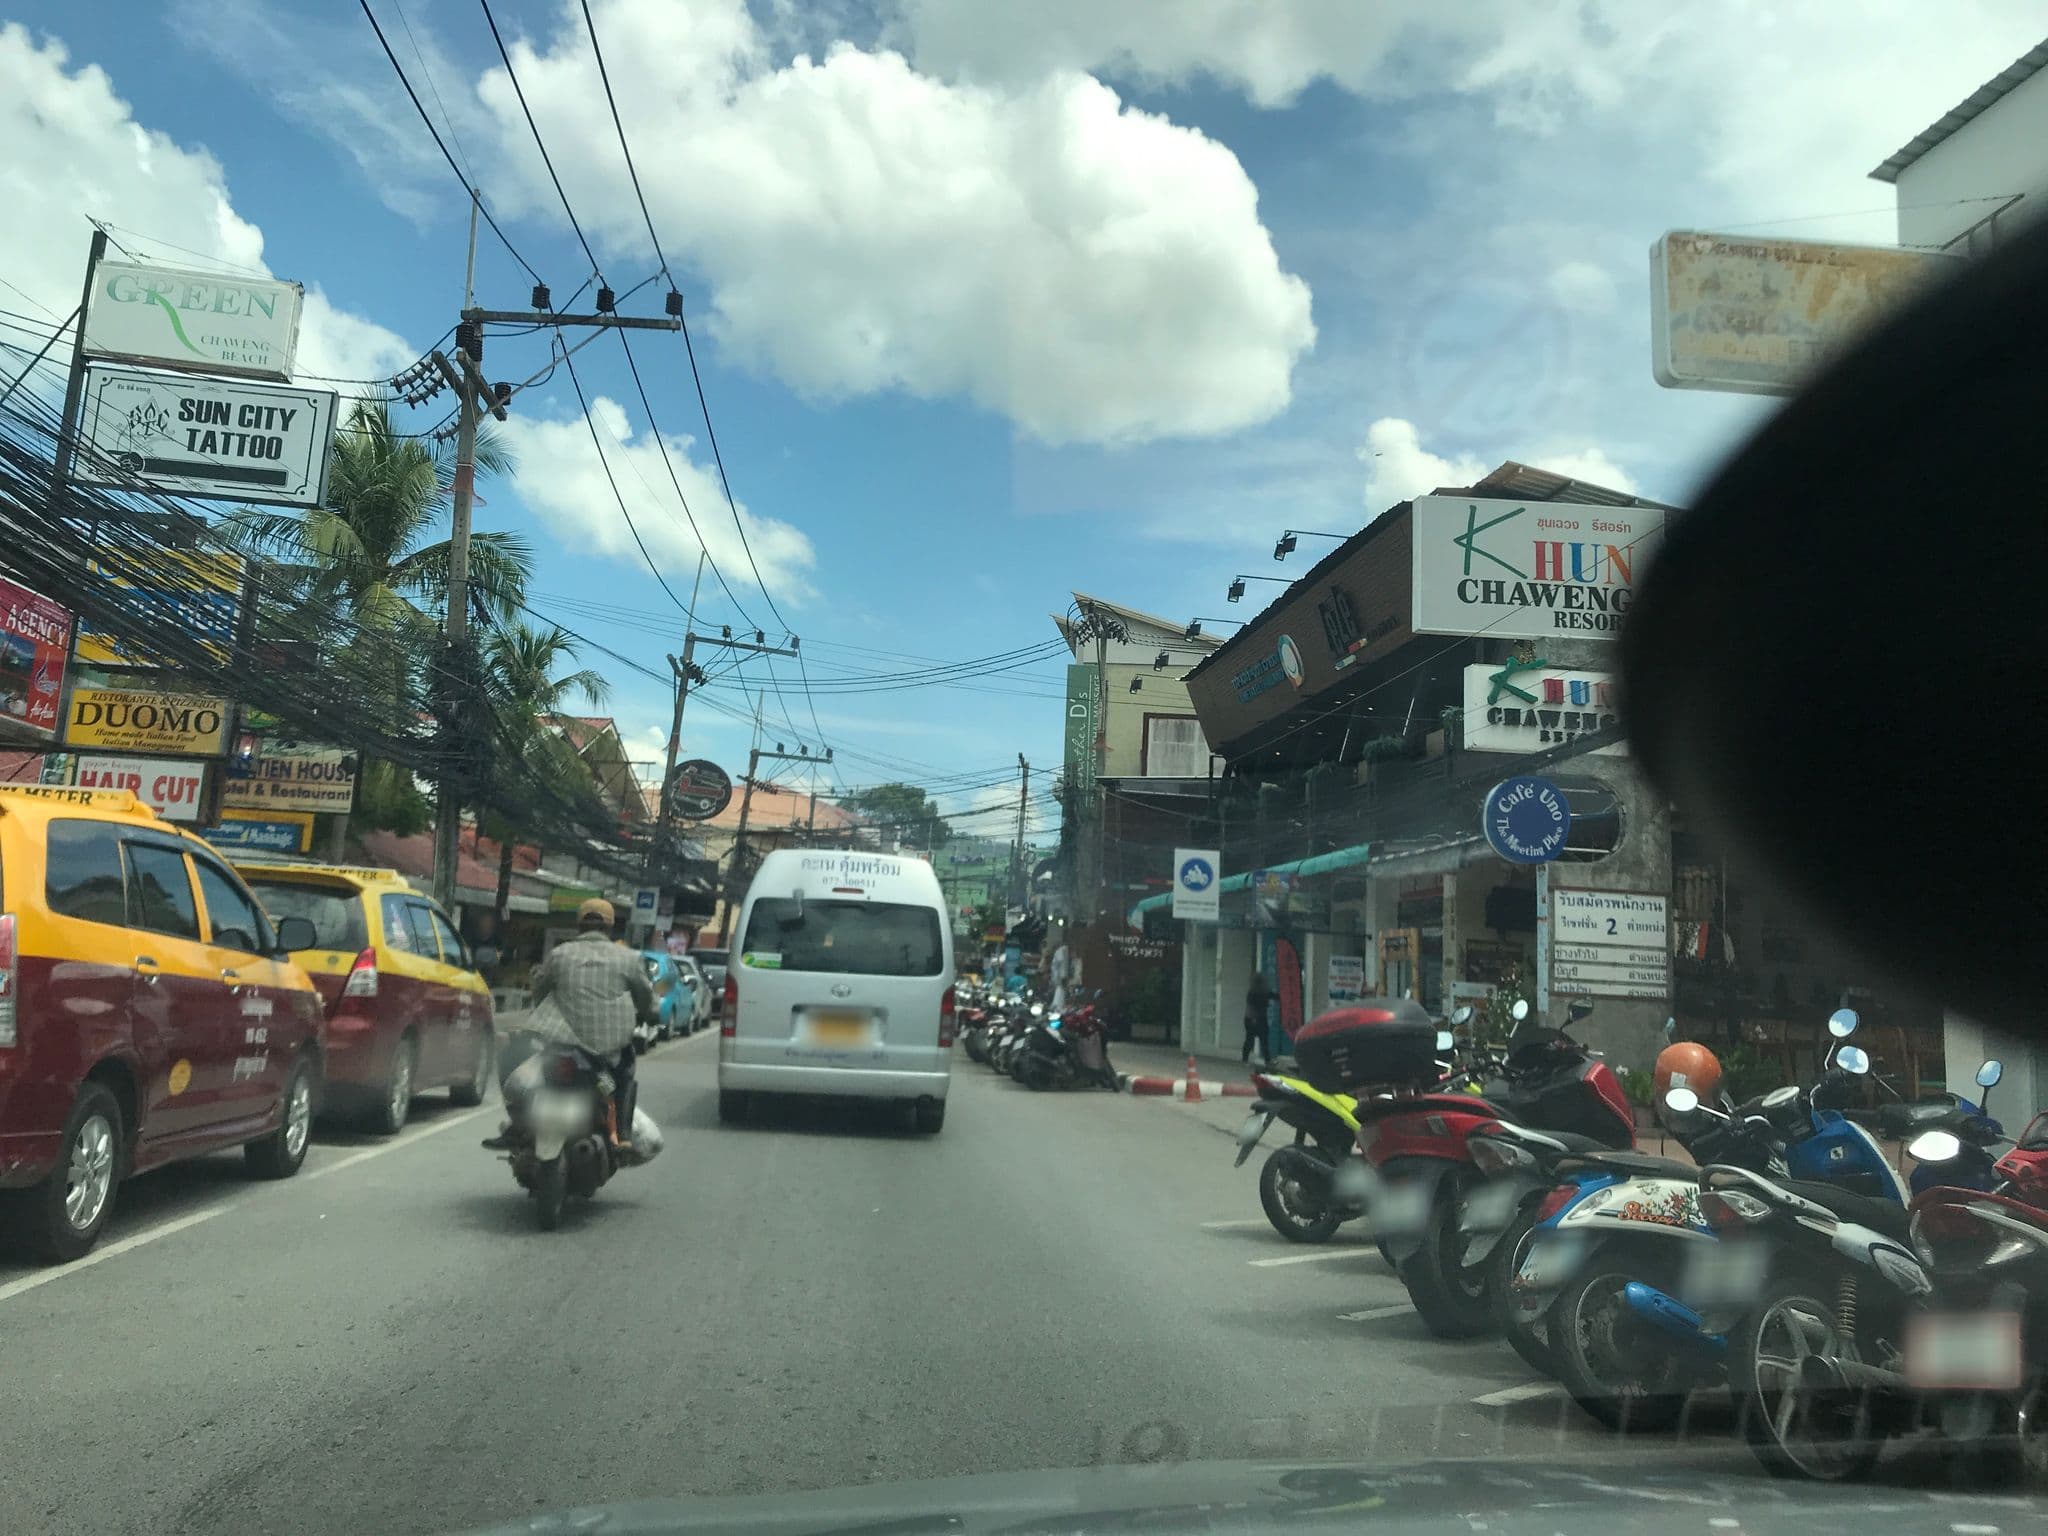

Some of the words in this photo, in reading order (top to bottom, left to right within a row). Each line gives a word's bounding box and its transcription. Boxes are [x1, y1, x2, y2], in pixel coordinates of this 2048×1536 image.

[178, 398, 232, 426] SUN
[237, 404, 297, 432] CITY
[186, 427, 283, 461] TATTOO
[1453, 504, 1635, 586] KHUN
[1456, 578, 1634, 614] CHAWENG
[5, 603, 67, 649] AGENCY
[1554, 610, 1627, 632] RESOR
[90, 692, 157, 705] RISTORANTE
[73, 701, 220, 735] DUOMO
[146, 730, 174, 740] Italian
[102, 737, 131, 746] Italian
[80, 770, 142, 800] HAIR
[152, 775, 200, 804] CUT
[270, 784, 351, 800] Restaurant
[1498, 783, 1534, 813] Café
[1539, 787, 1563, 821] Uno
[1559, 891, 1663, 913] รับสมัครพนักงาน
[1606, 918, 1618, 936] 2
